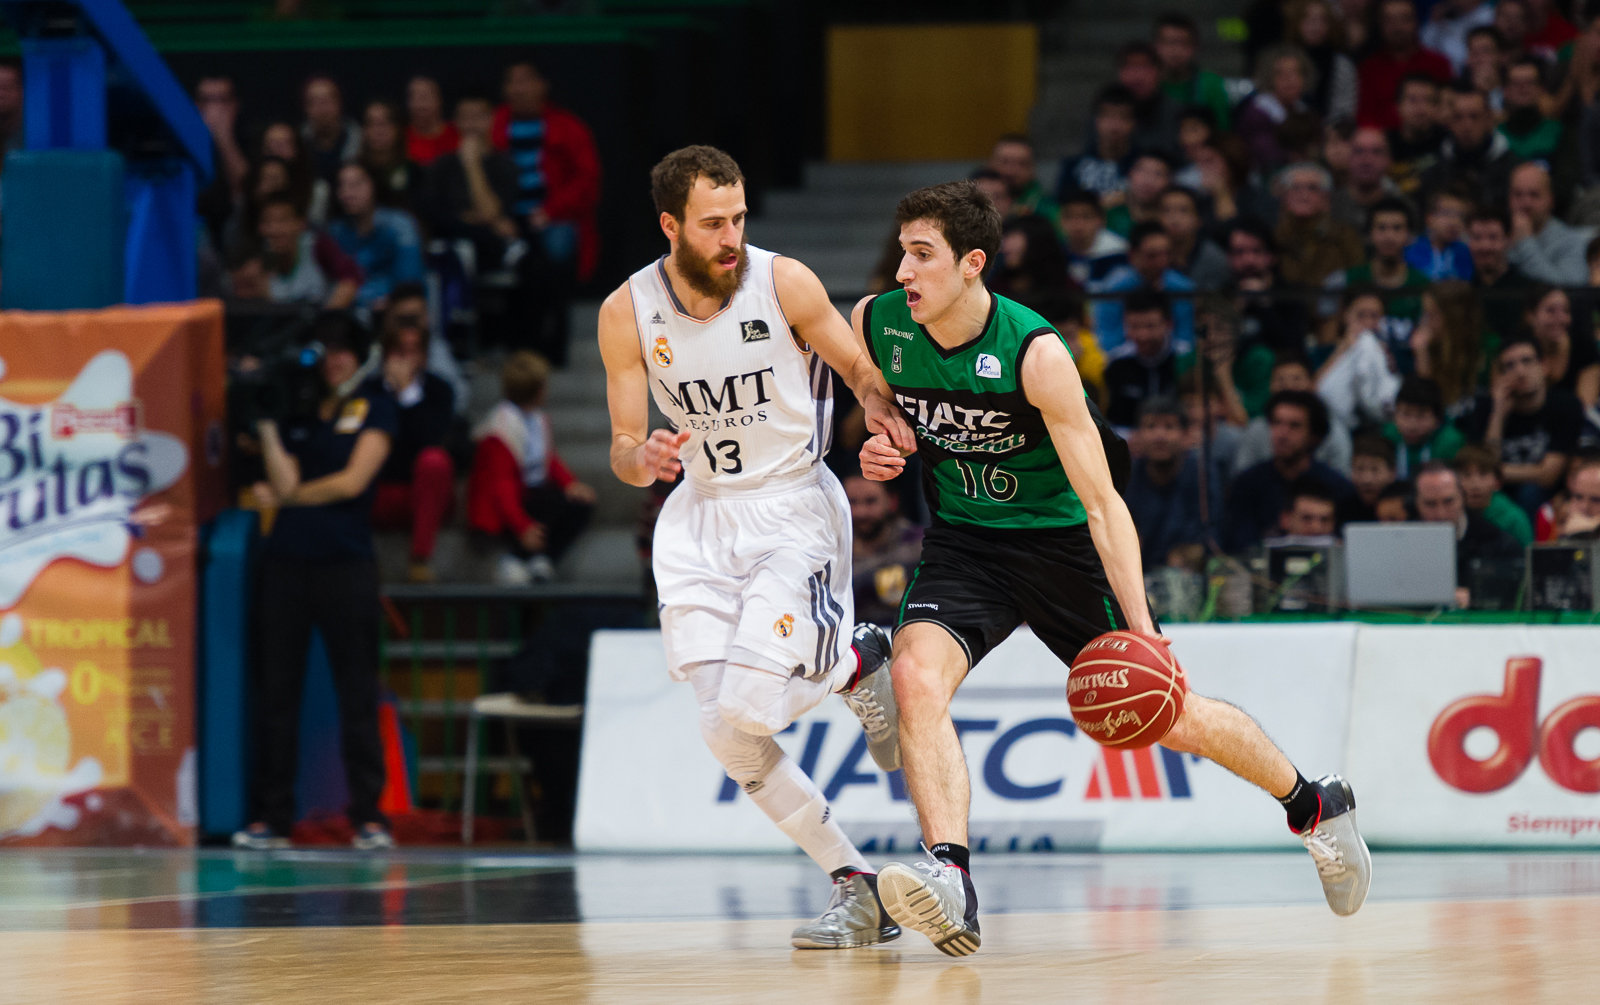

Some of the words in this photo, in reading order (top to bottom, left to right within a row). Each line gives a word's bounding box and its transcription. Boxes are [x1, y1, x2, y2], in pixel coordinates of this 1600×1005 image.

[884, 326, 914, 341] SPALDING
[658, 366, 775, 416] MMT
[685, 410, 768, 431] EGUROS
[895, 393, 1012, 431] FIATC
[703, 439, 742, 474] 13
[0, 441, 151, 531] utas
[955, 459, 1018, 501] 16
[1067, 668, 1129, 698] SPALDIN
[717, 718, 1076, 801] IAC
[1507, 809, 1600, 839] Siempr
